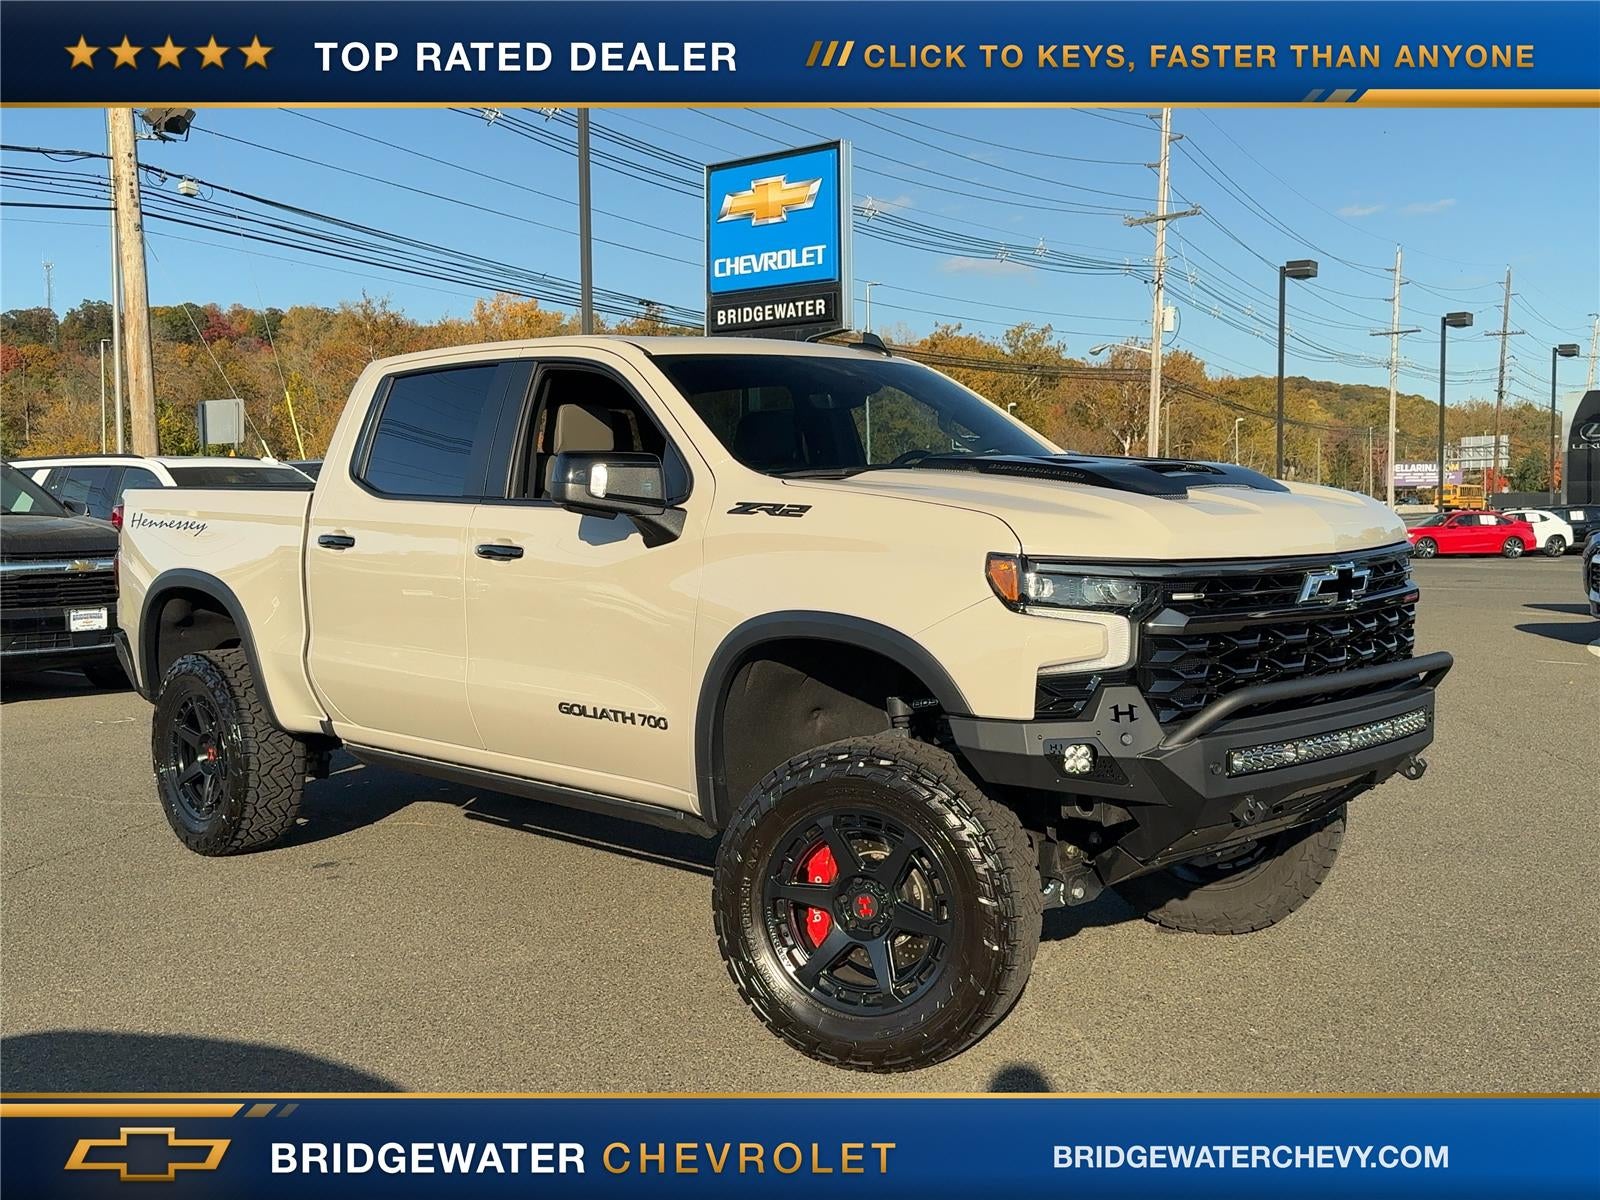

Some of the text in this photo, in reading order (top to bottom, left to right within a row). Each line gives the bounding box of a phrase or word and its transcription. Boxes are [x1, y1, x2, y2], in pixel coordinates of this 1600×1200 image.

[714, 245, 826, 278] CHEVROLET
[717, 299, 826, 326] BRIDGEWATER
[727, 502, 813, 518] ZR2
[131, 513, 208, 537] Hennessey
[558, 702, 668, 730] GOLIATH 700
